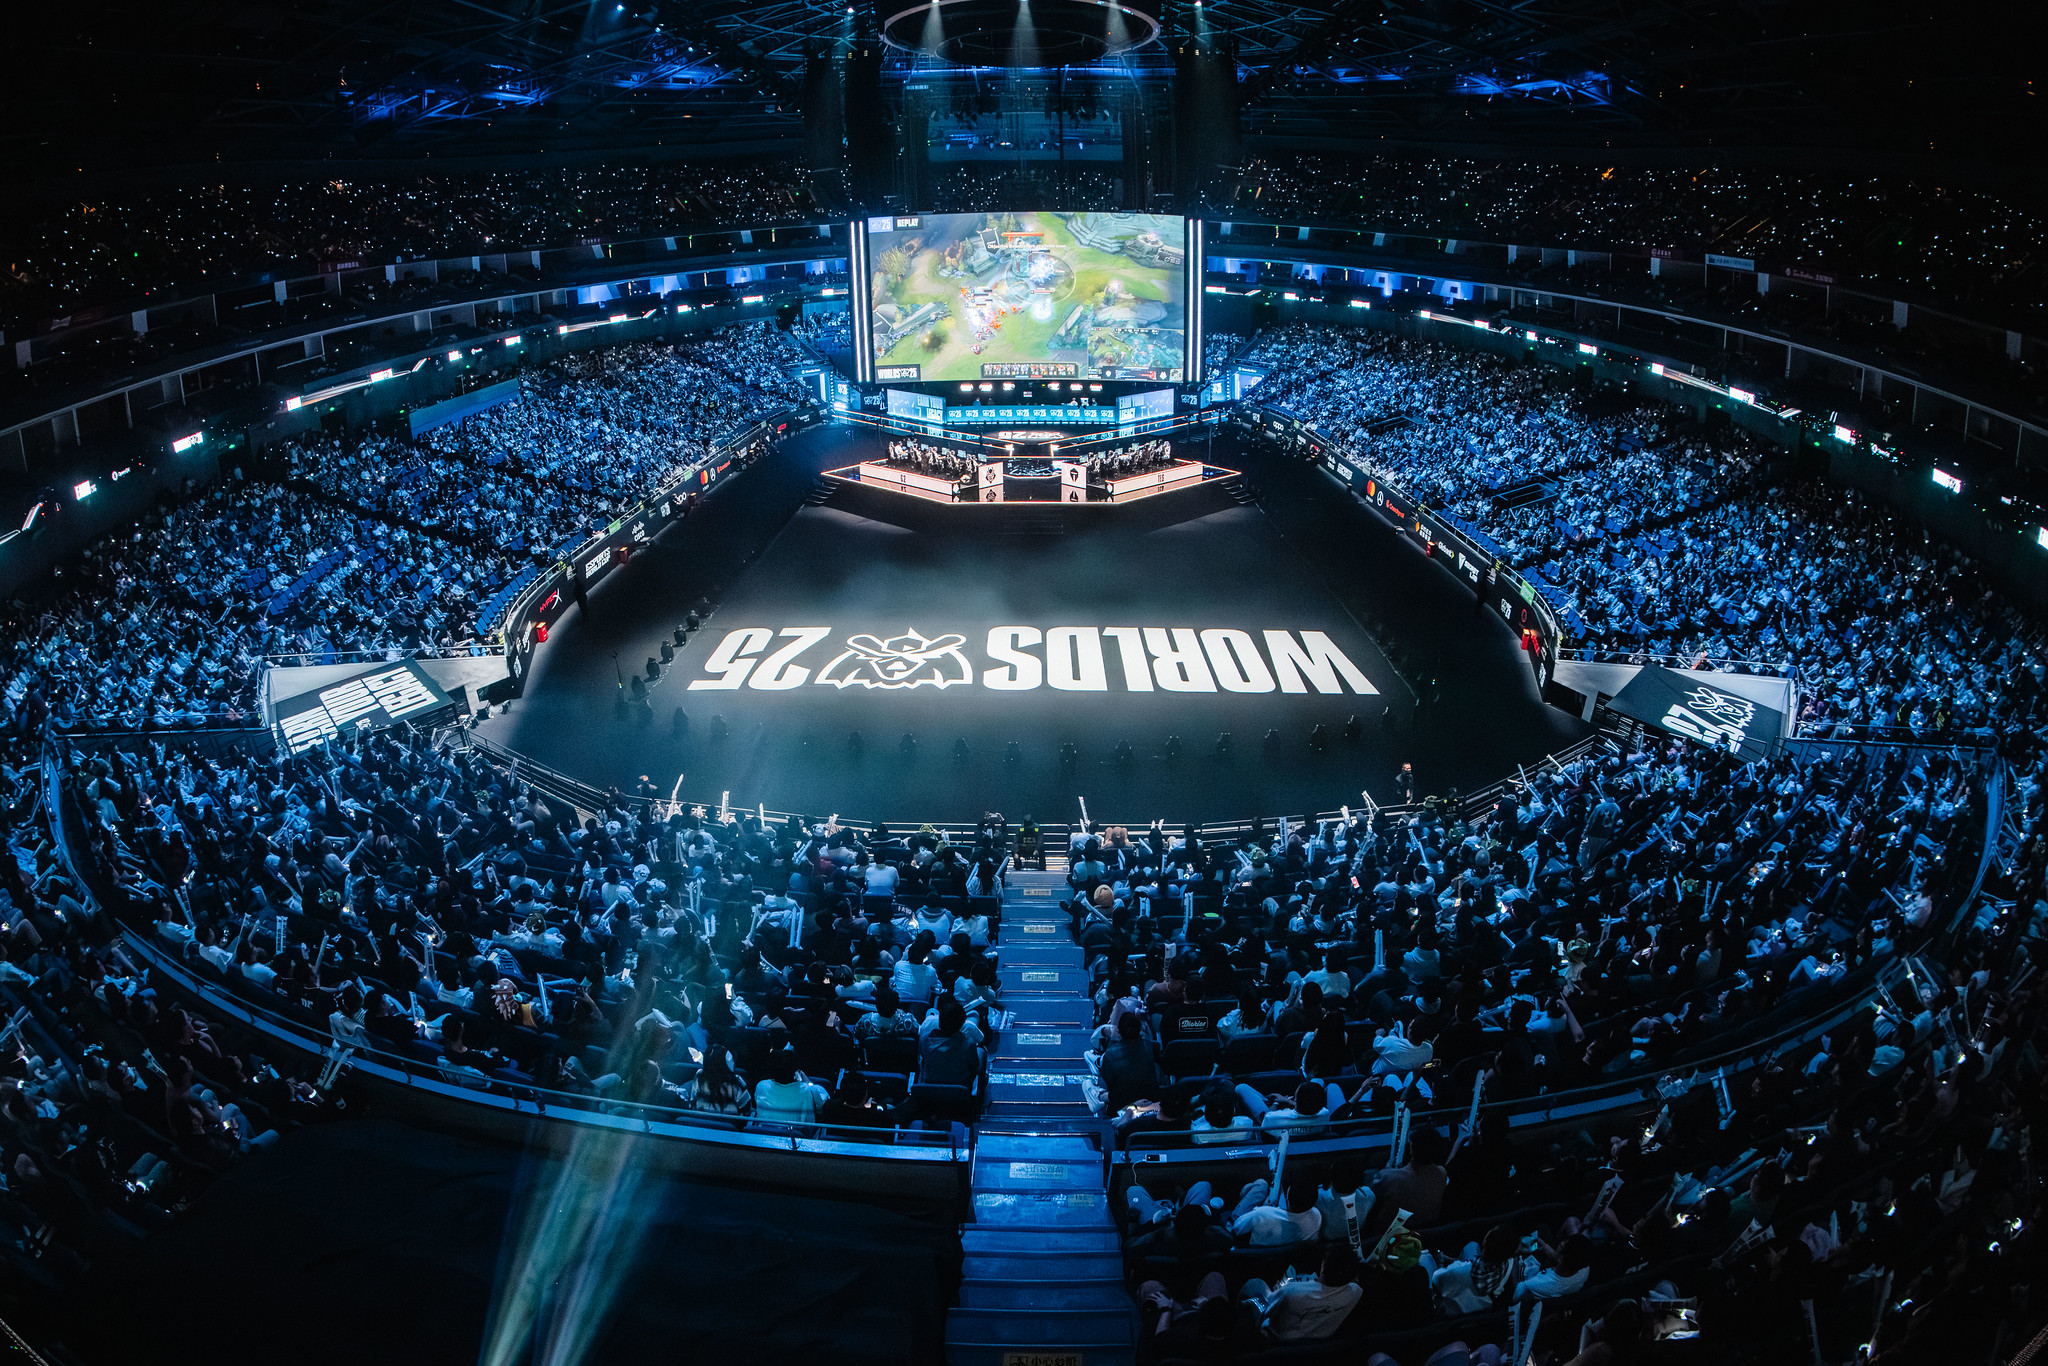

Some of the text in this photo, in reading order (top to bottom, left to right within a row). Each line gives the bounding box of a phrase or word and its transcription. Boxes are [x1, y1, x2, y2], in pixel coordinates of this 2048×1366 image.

[881, 218, 891, 230] 25
[897, 217, 919, 228] REPLAY
[878, 368, 901, 379] WORLDS
[926, 408, 943, 421] LEGACY
[1120, 408, 1136, 420] LEGACY
[585, 547, 611, 572] ESPORTS
[586, 561, 600, 578] WORLD
[687, 625, 1381, 696] WORLDS 25
[319, 679, 382, 727] YOUR
[361, 666, 439, 719] LEGACY
[279, 705, 338, 755] EARN
[1661, 704, 1746, 755] 25
